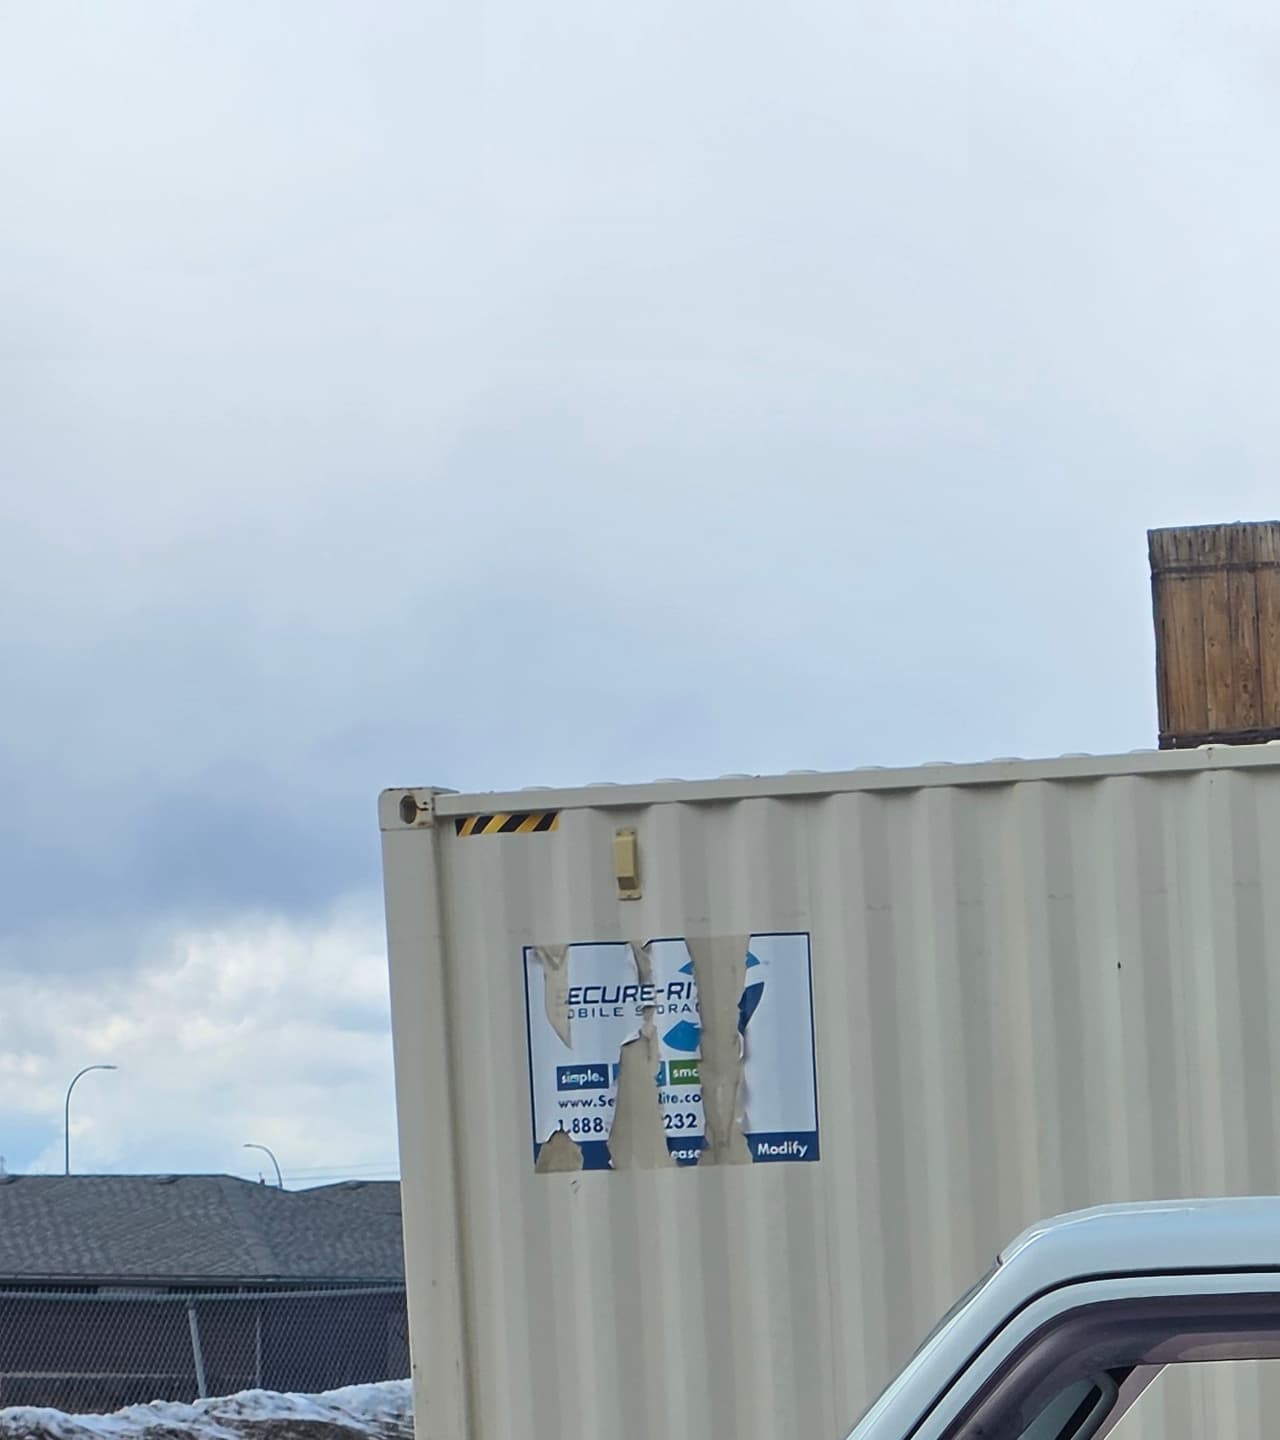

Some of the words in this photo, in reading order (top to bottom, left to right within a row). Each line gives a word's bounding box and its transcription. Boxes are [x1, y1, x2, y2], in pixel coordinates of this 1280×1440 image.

[566, 982, 694, 1005] ECURE-RI
[568, 1007, 624, 1019] OBILE
[561, 1069, 604, 1086] simple.
[663, 1113, 698, 1129] 232
[757, 1140, 808, 1157] Modify
